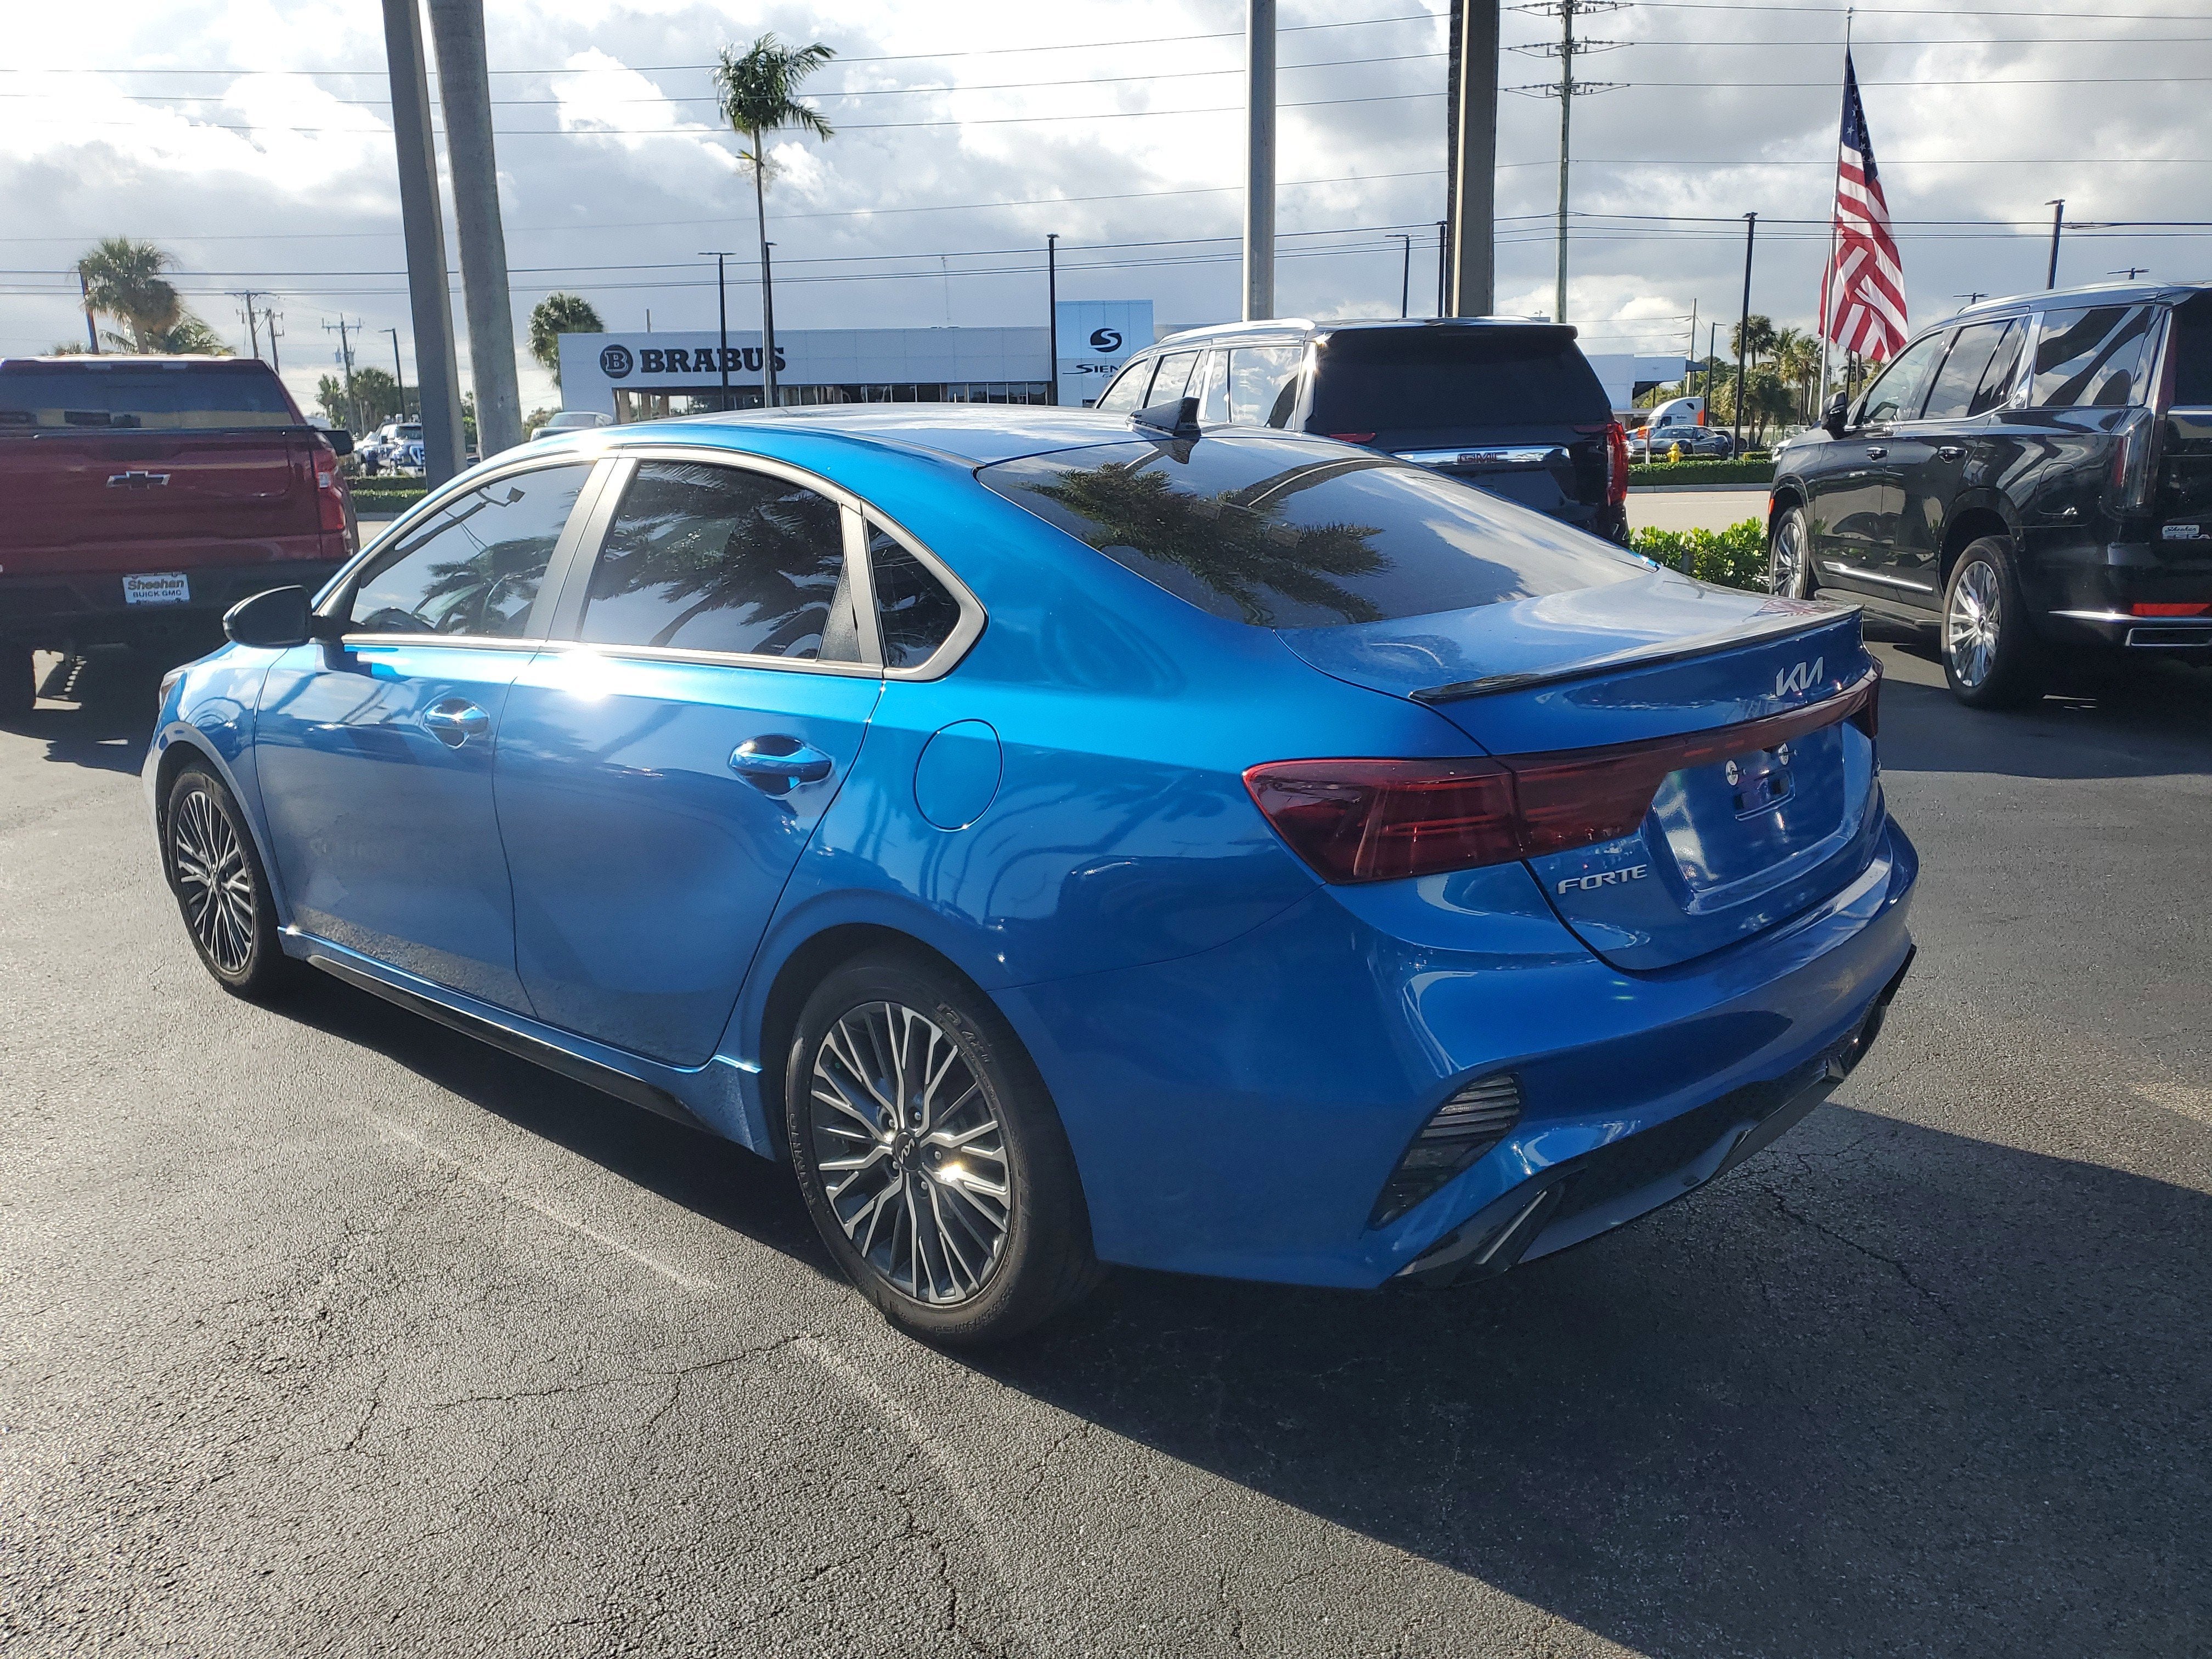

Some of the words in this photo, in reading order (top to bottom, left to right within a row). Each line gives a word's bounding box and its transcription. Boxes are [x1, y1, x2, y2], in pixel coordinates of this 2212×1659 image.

[639, 347, 786, 373] BRABUS
[1457, 452, 1508, 463] GMC
[128, 578, 184, 590] Sheehan
[133, 590, 160, 598] BUICK
[1558, 864, 1647, 895] FORTE
